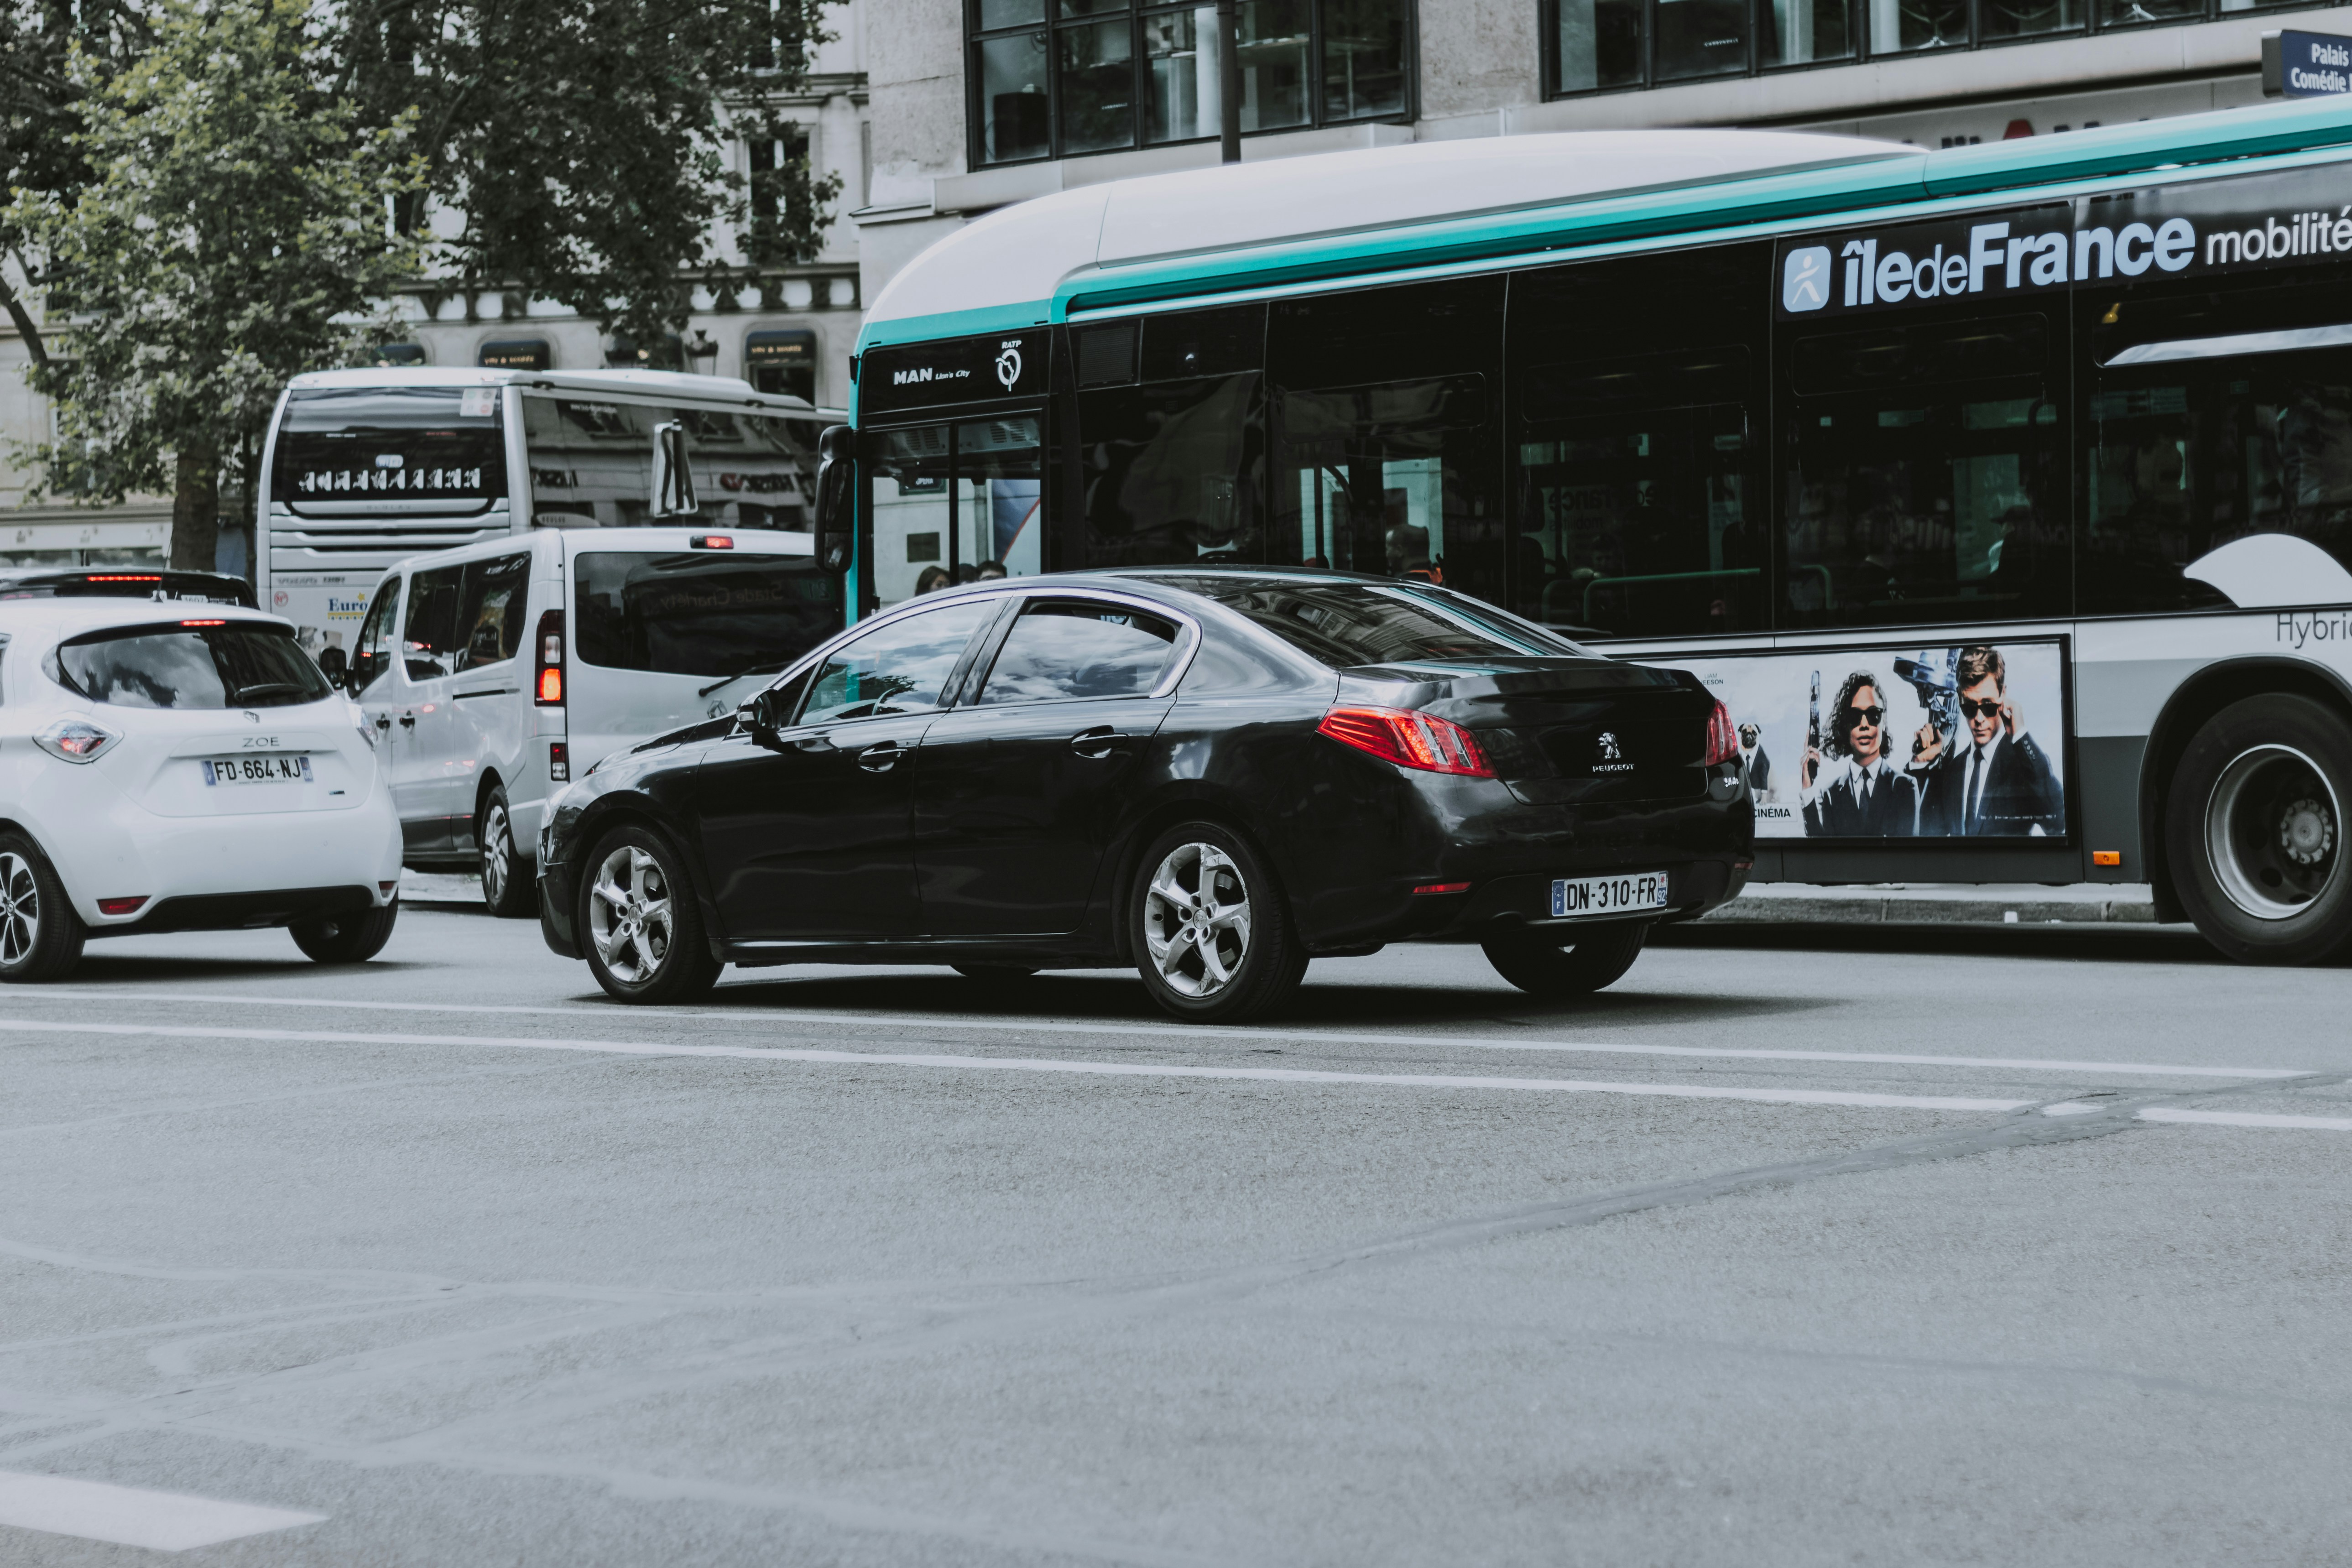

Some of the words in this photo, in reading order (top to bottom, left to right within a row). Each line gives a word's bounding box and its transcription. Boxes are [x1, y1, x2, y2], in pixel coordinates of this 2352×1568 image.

[2311, 43, 2349, 67] Palais
[2290, 67, 2347, 92] Comédie
[2207, 205, 2352, 265] mobilité
[1001, 340, 1022, 349] RATP
[894, 368, 933, 385] MAN
[329, 598, 367, 611] Euro
[2277, 612, 2352, 649] Hybri
[242, 737, 280, 747] ZOE
[214, 759, 301, 781] FD-664-NJ
[1592, 764, 1635, 772] PEUGEOT
[1567, 877, 1656, 910] DN-310-FR
[1658, 890, 1665, 902] 92
